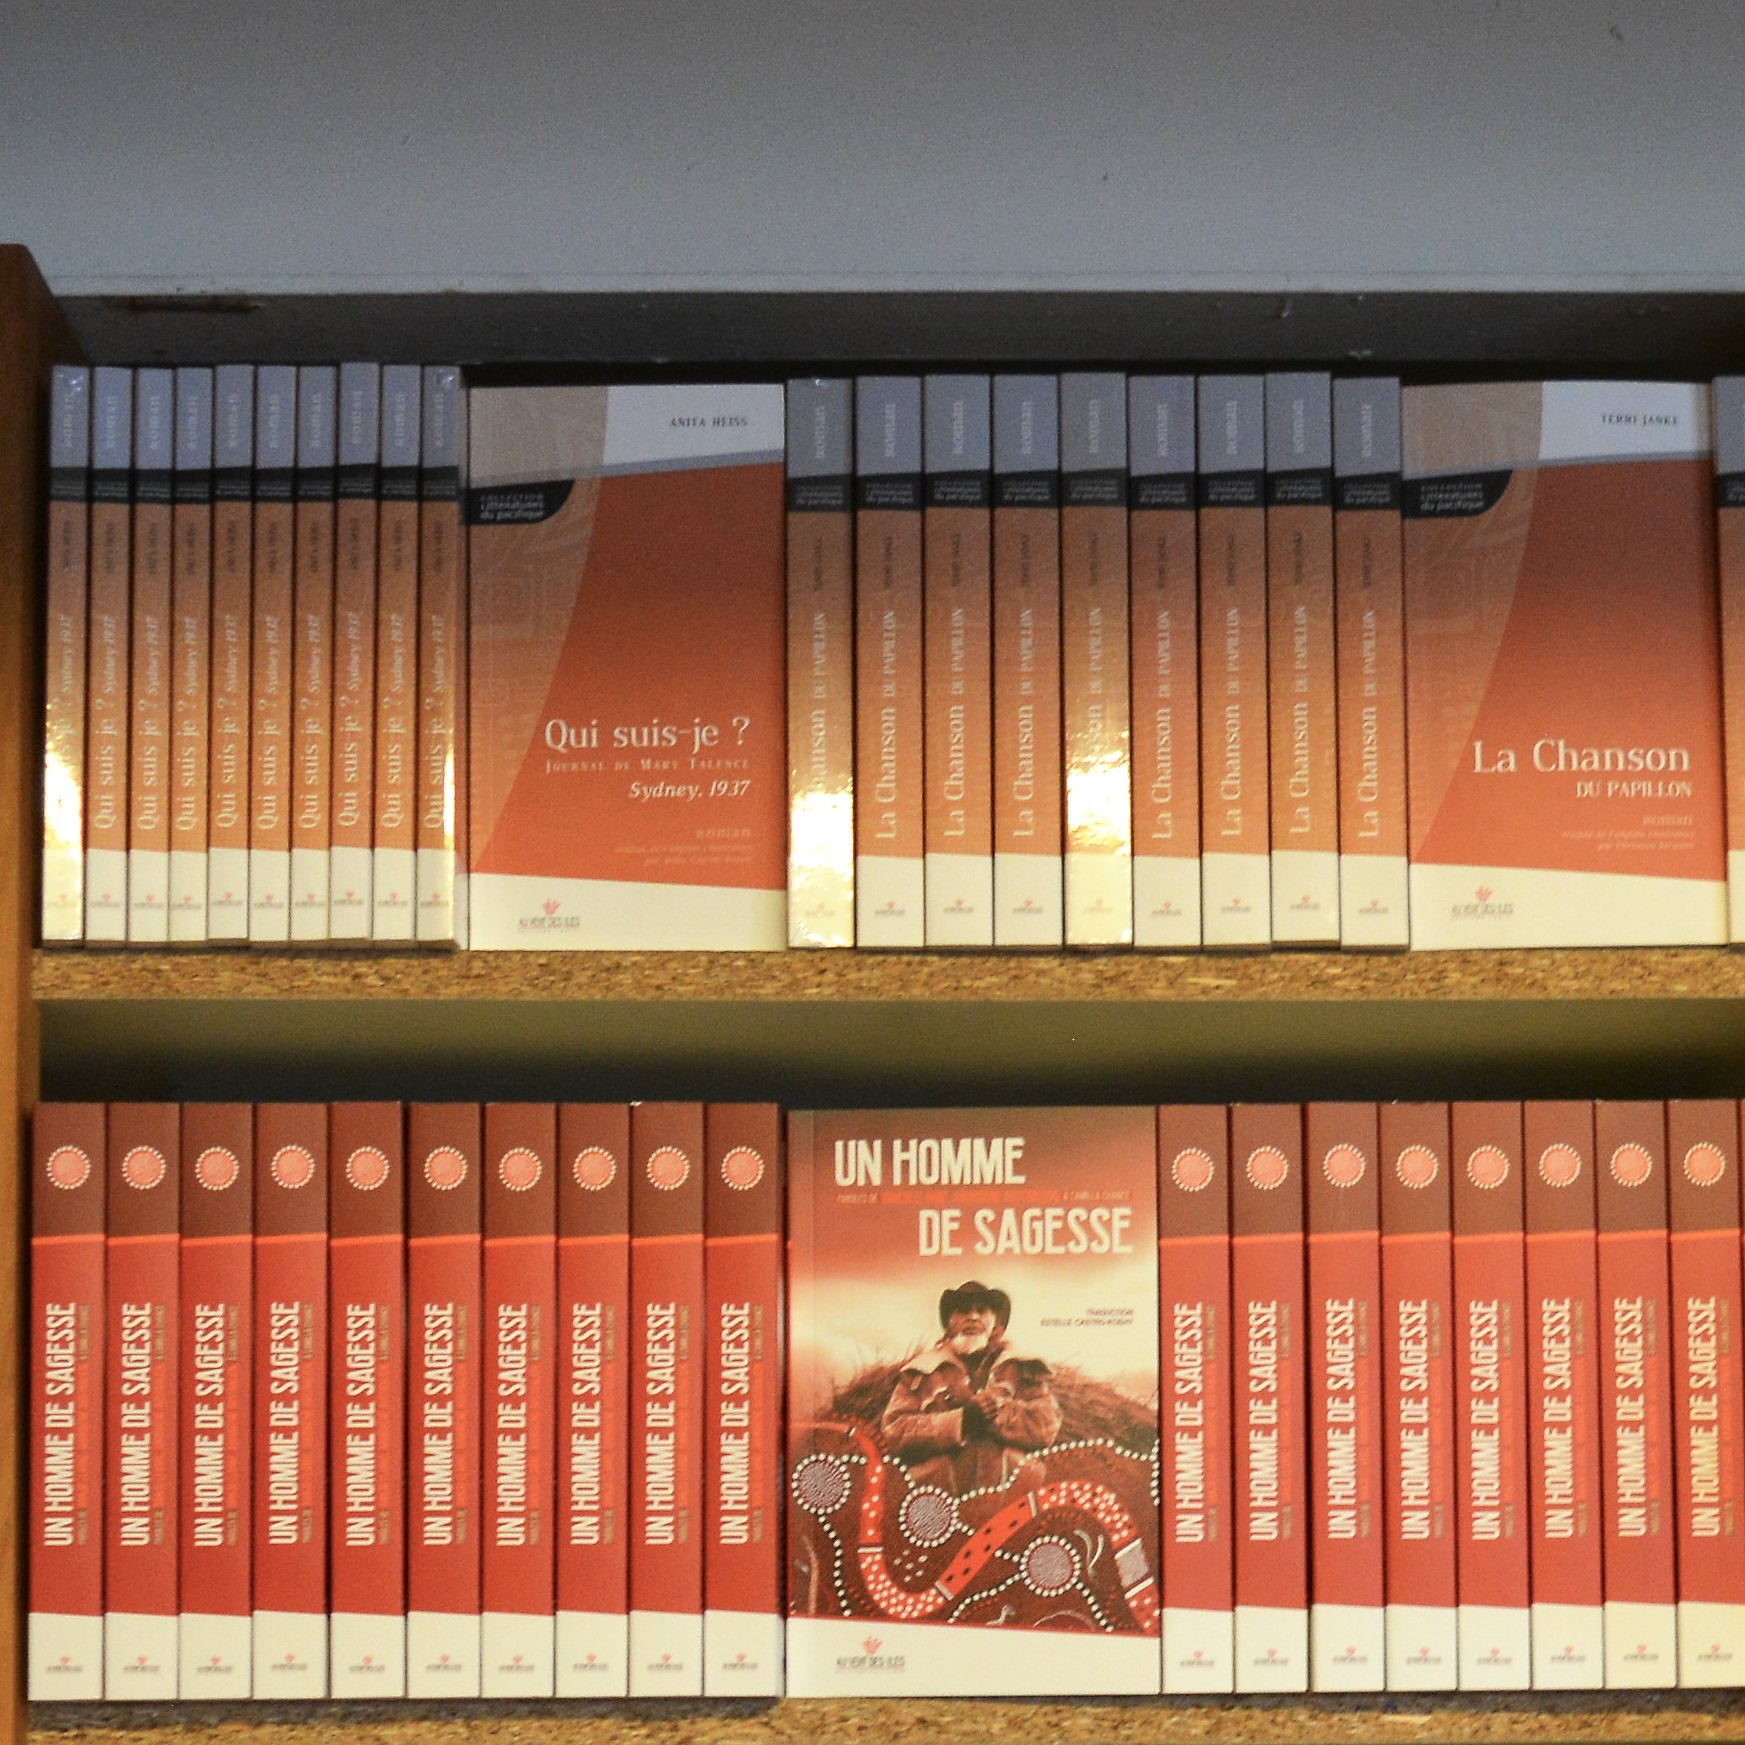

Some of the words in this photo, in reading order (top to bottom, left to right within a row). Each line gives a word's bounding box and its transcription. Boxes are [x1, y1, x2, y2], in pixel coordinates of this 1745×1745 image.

[545, 718, 598, 753] Qui
[613, 716, 719, 754] suis-je
[732, 716, 751, 745] ?
[874, 707, 897, 803] Chanson
[1473, 740, 1517, 773] La
[1533, 737, 1691, 773] Chanson
[709, 780, 751, 797] 1937
[1576, 781, 1599, 798] DU
[1607, 780, 1692, 798] PAPILLON
[94, 794, 116, 829] Qui
[875, 811, 896, 838] La
[834, 1139, 882, 1187] UN
[892, 1136, 1027, 1186] HOMME
[918, 1209, 963, 1257] DE
[973, 1206, 1134, 1256] SAGESSE
[45, 1302, 75, 1395] SAGESSE
[571, 1302, 602, 1395] SAGESSE
[1249, 1300, 1278, 1392] SAGESSE
[44, 1401, 74, 1428] DE
[571, 1400, 601, 1427] DE
[1249, 1398, 1278, 1424] DE
[44, 1432, 74, 1511] HOMME
[570, 1432, 600, 1510] HOMME
[1249, 1428, 1278, 1506] HOMME
[44, 1516, 73, 1545] UN
[570, 1515, 599, 1544] UN
[1249, 1511, 1278, 1540] UN
